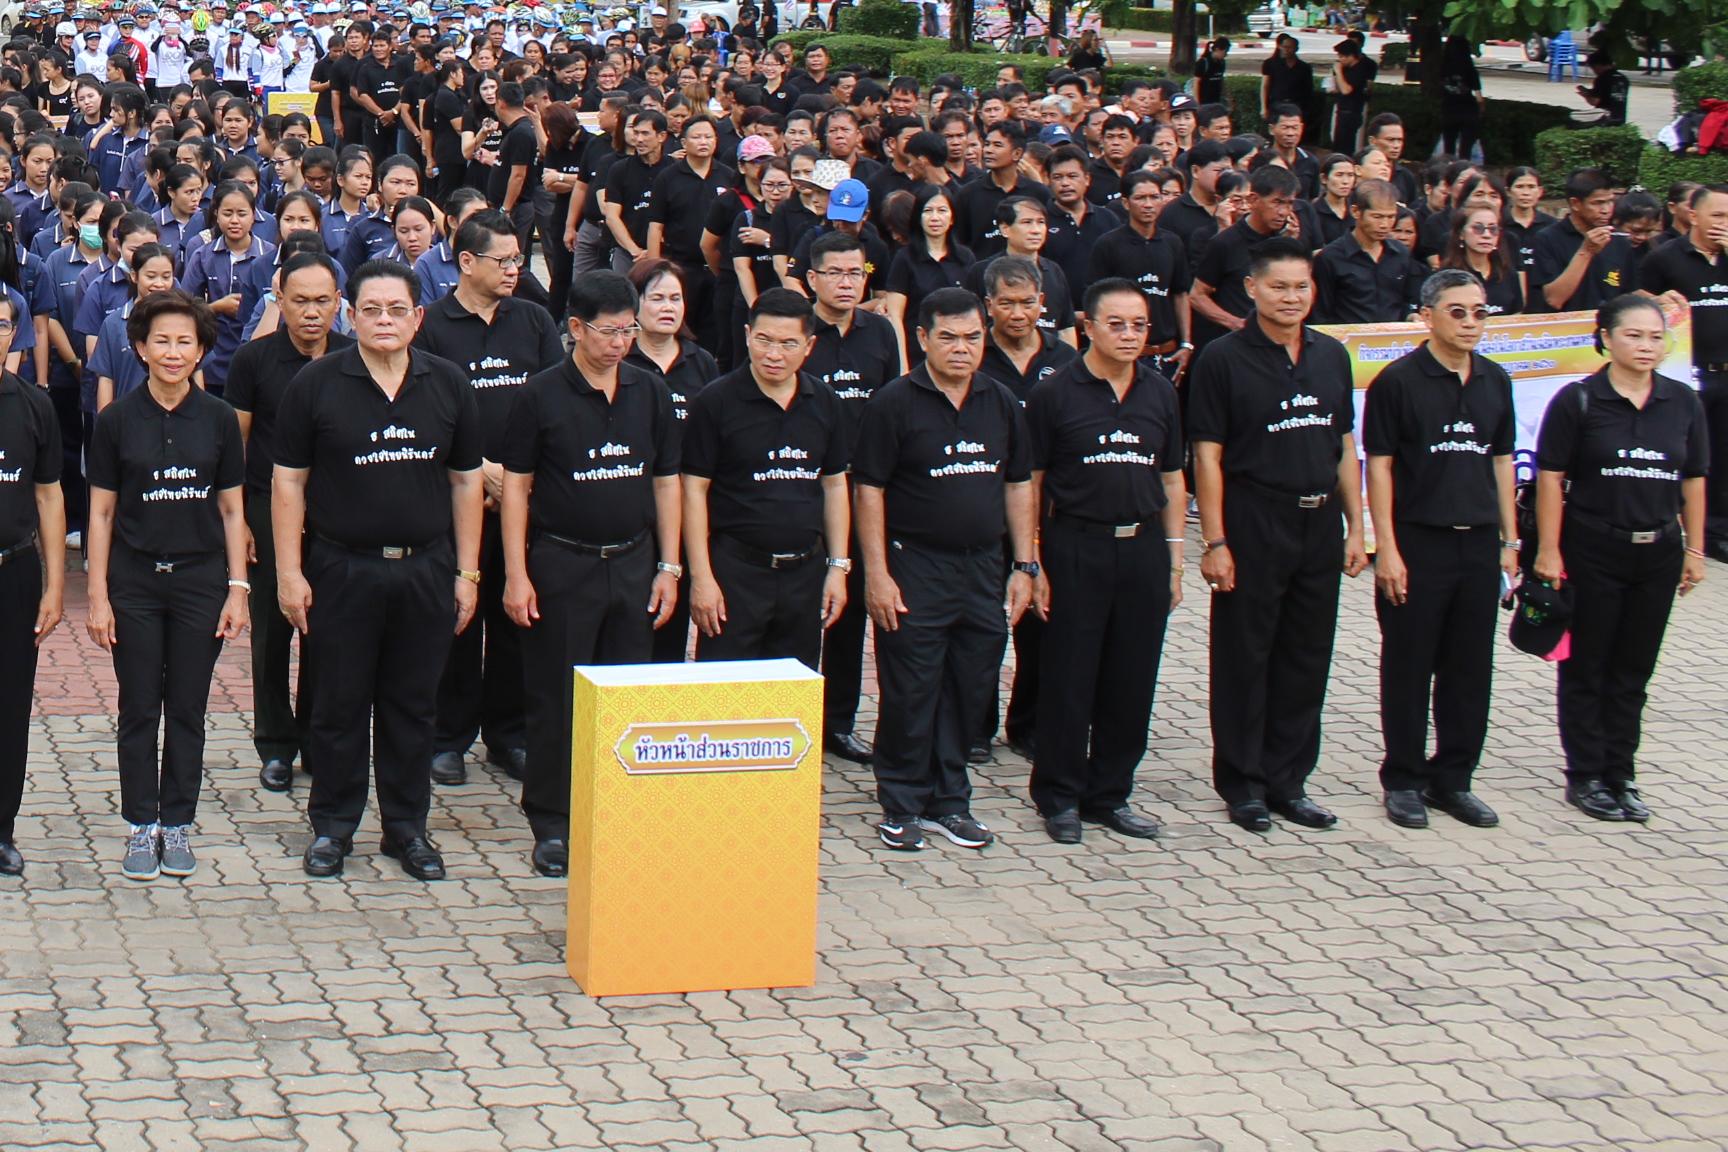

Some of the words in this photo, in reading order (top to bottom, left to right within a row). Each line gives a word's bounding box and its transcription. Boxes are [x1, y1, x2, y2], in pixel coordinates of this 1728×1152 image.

[370, 431, 377, 442] ธ
[383, 425, 415, 439] สถิตใน
[1099, 435, 1106, 444] ธ
[588, 449, 595, 459] ธ
[600, 442, 630, 457] สถิตใน
[768, 451, 774, 460] ธ
[944, 445, 952, 455] ธ
[153, 471, 159, 480] ธ
[164, 465, 196, 480] สถิตใน
[635, 732, 792, 762] หัวหน้าส่วนราชการ
